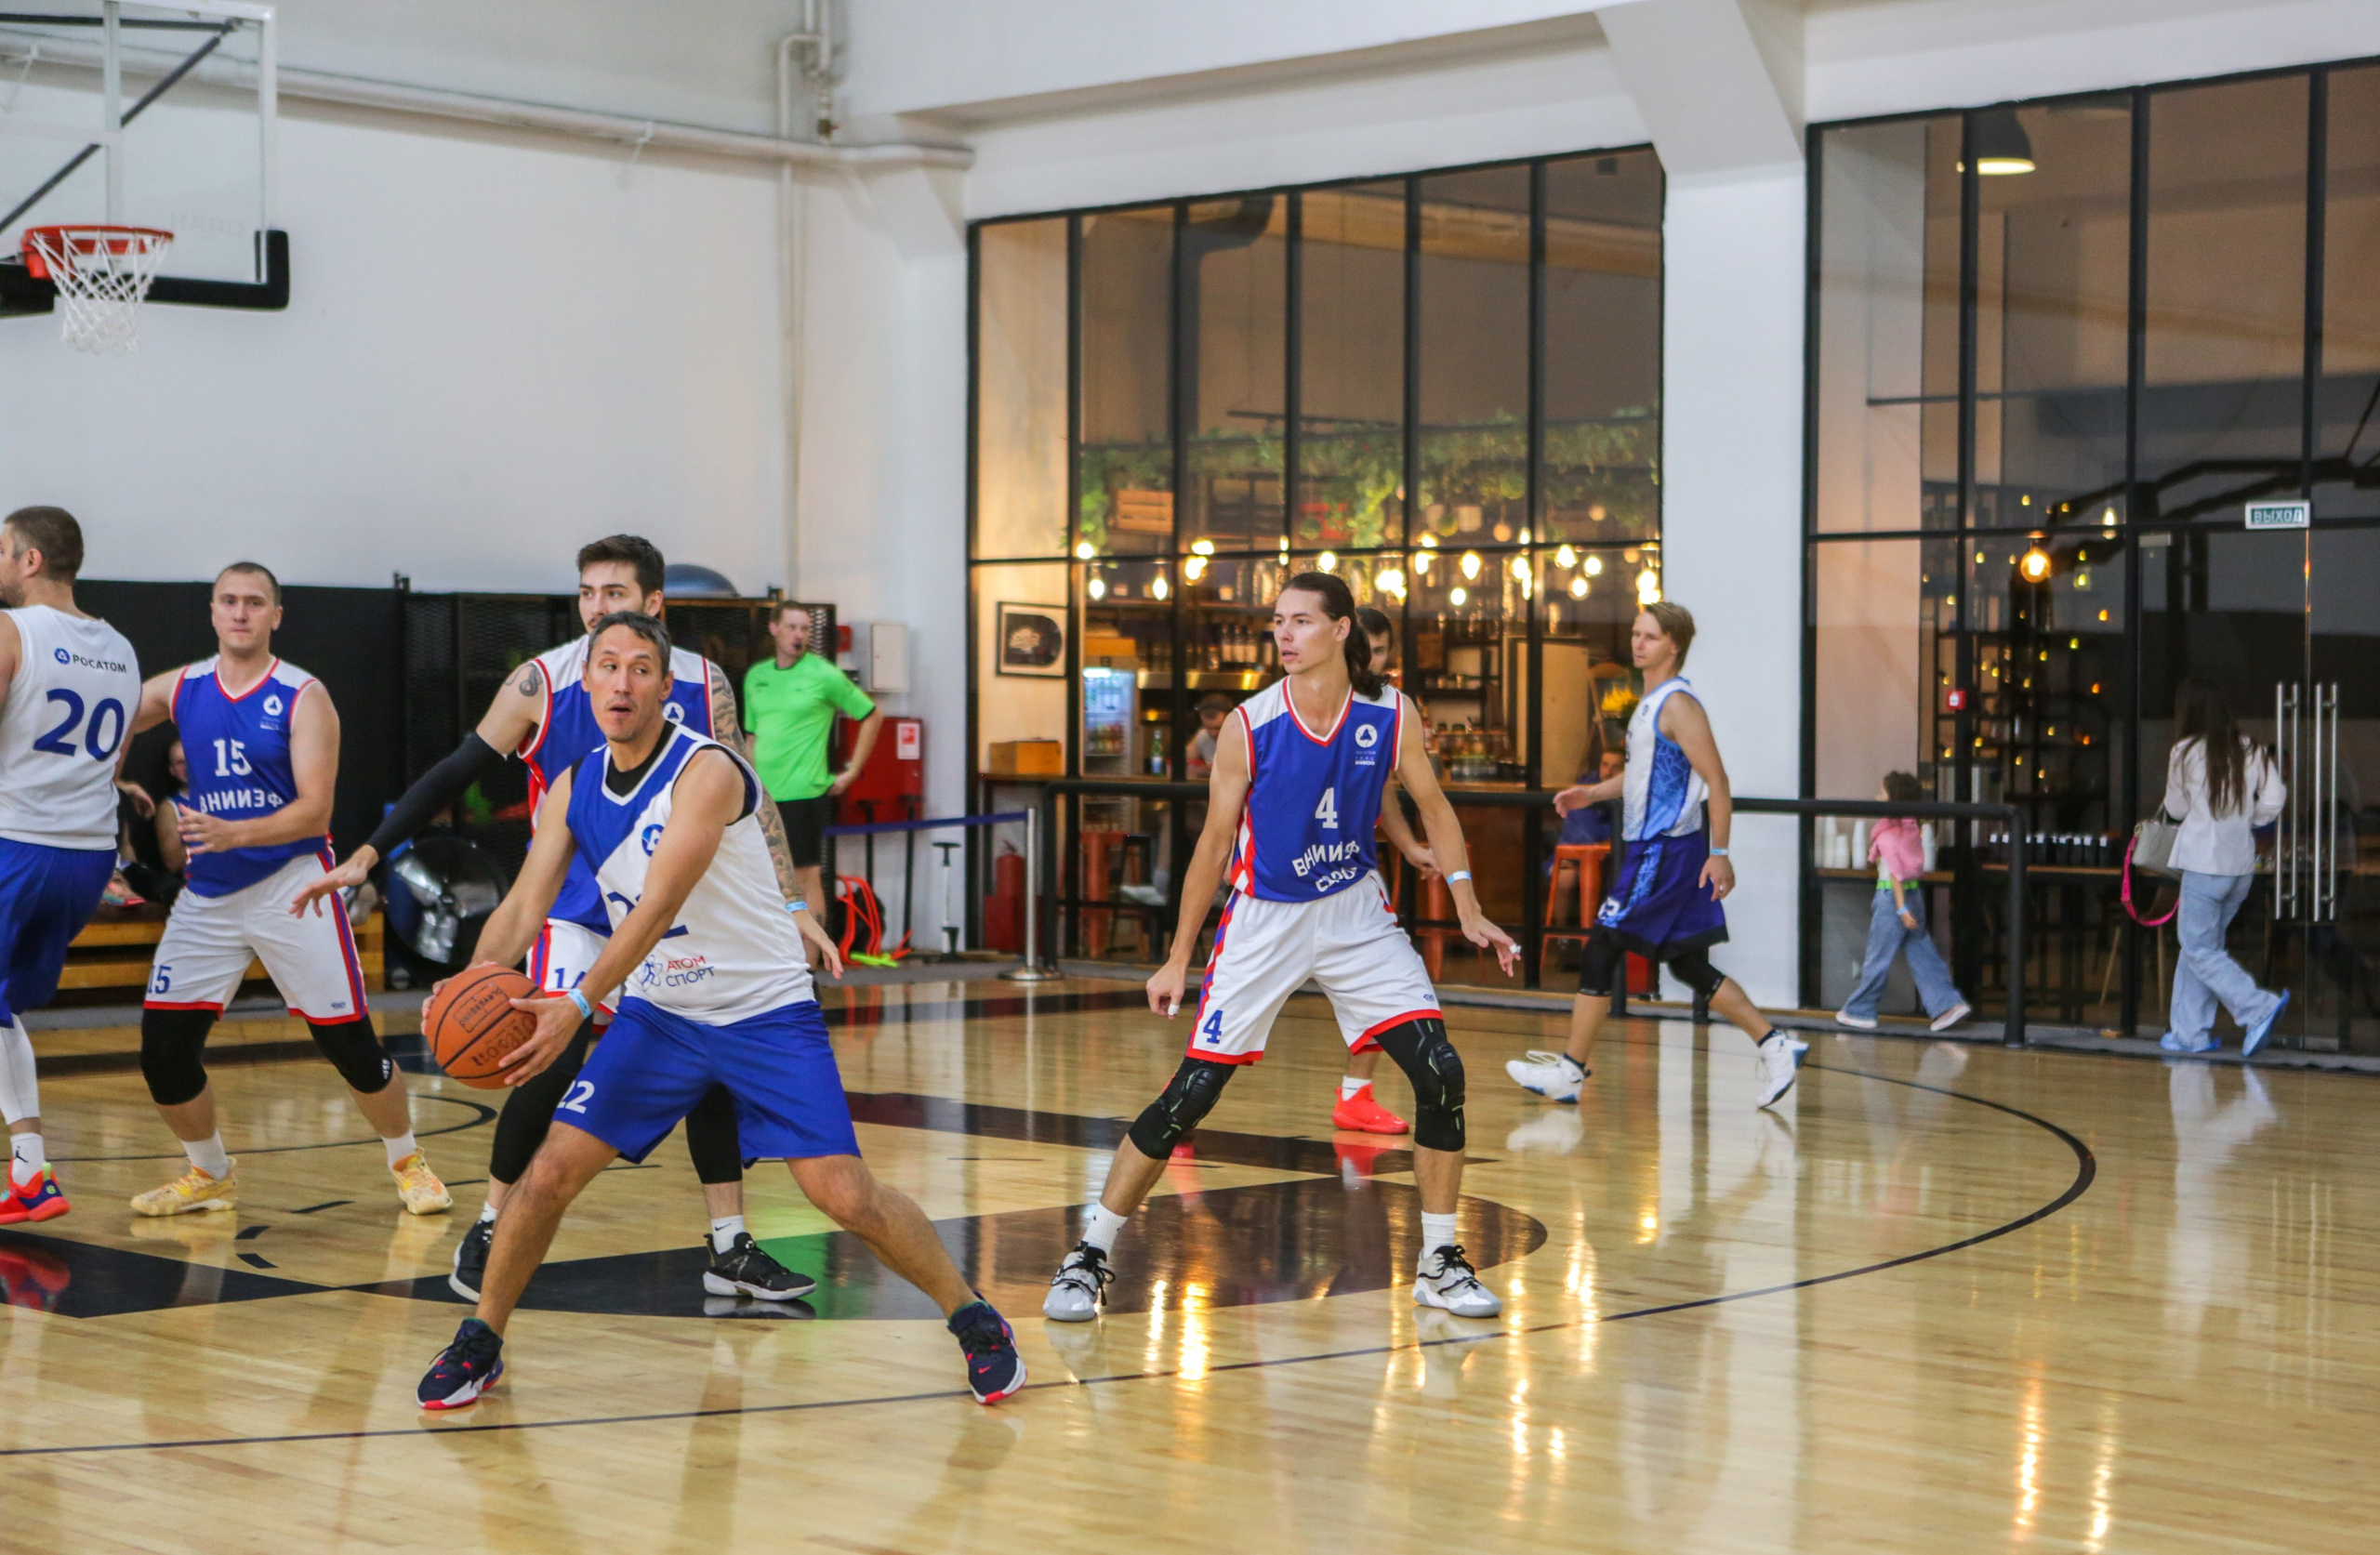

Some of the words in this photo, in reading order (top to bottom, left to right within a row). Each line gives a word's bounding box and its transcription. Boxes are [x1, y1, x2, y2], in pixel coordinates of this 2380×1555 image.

[2254, 509, 2303, 524] ВЫХОД
[73, 654, 127, 674] РОСАТОМ
[33, 688, 125, 762] 20
[213, 738, 252, 777] 15
[1315, 787, 1339, 829] 4
[666, 955, 707, 972] АТОМ
[666, 966, 715, 988] СПОРТ
[1202, 1009, 1223, 1045] 4
